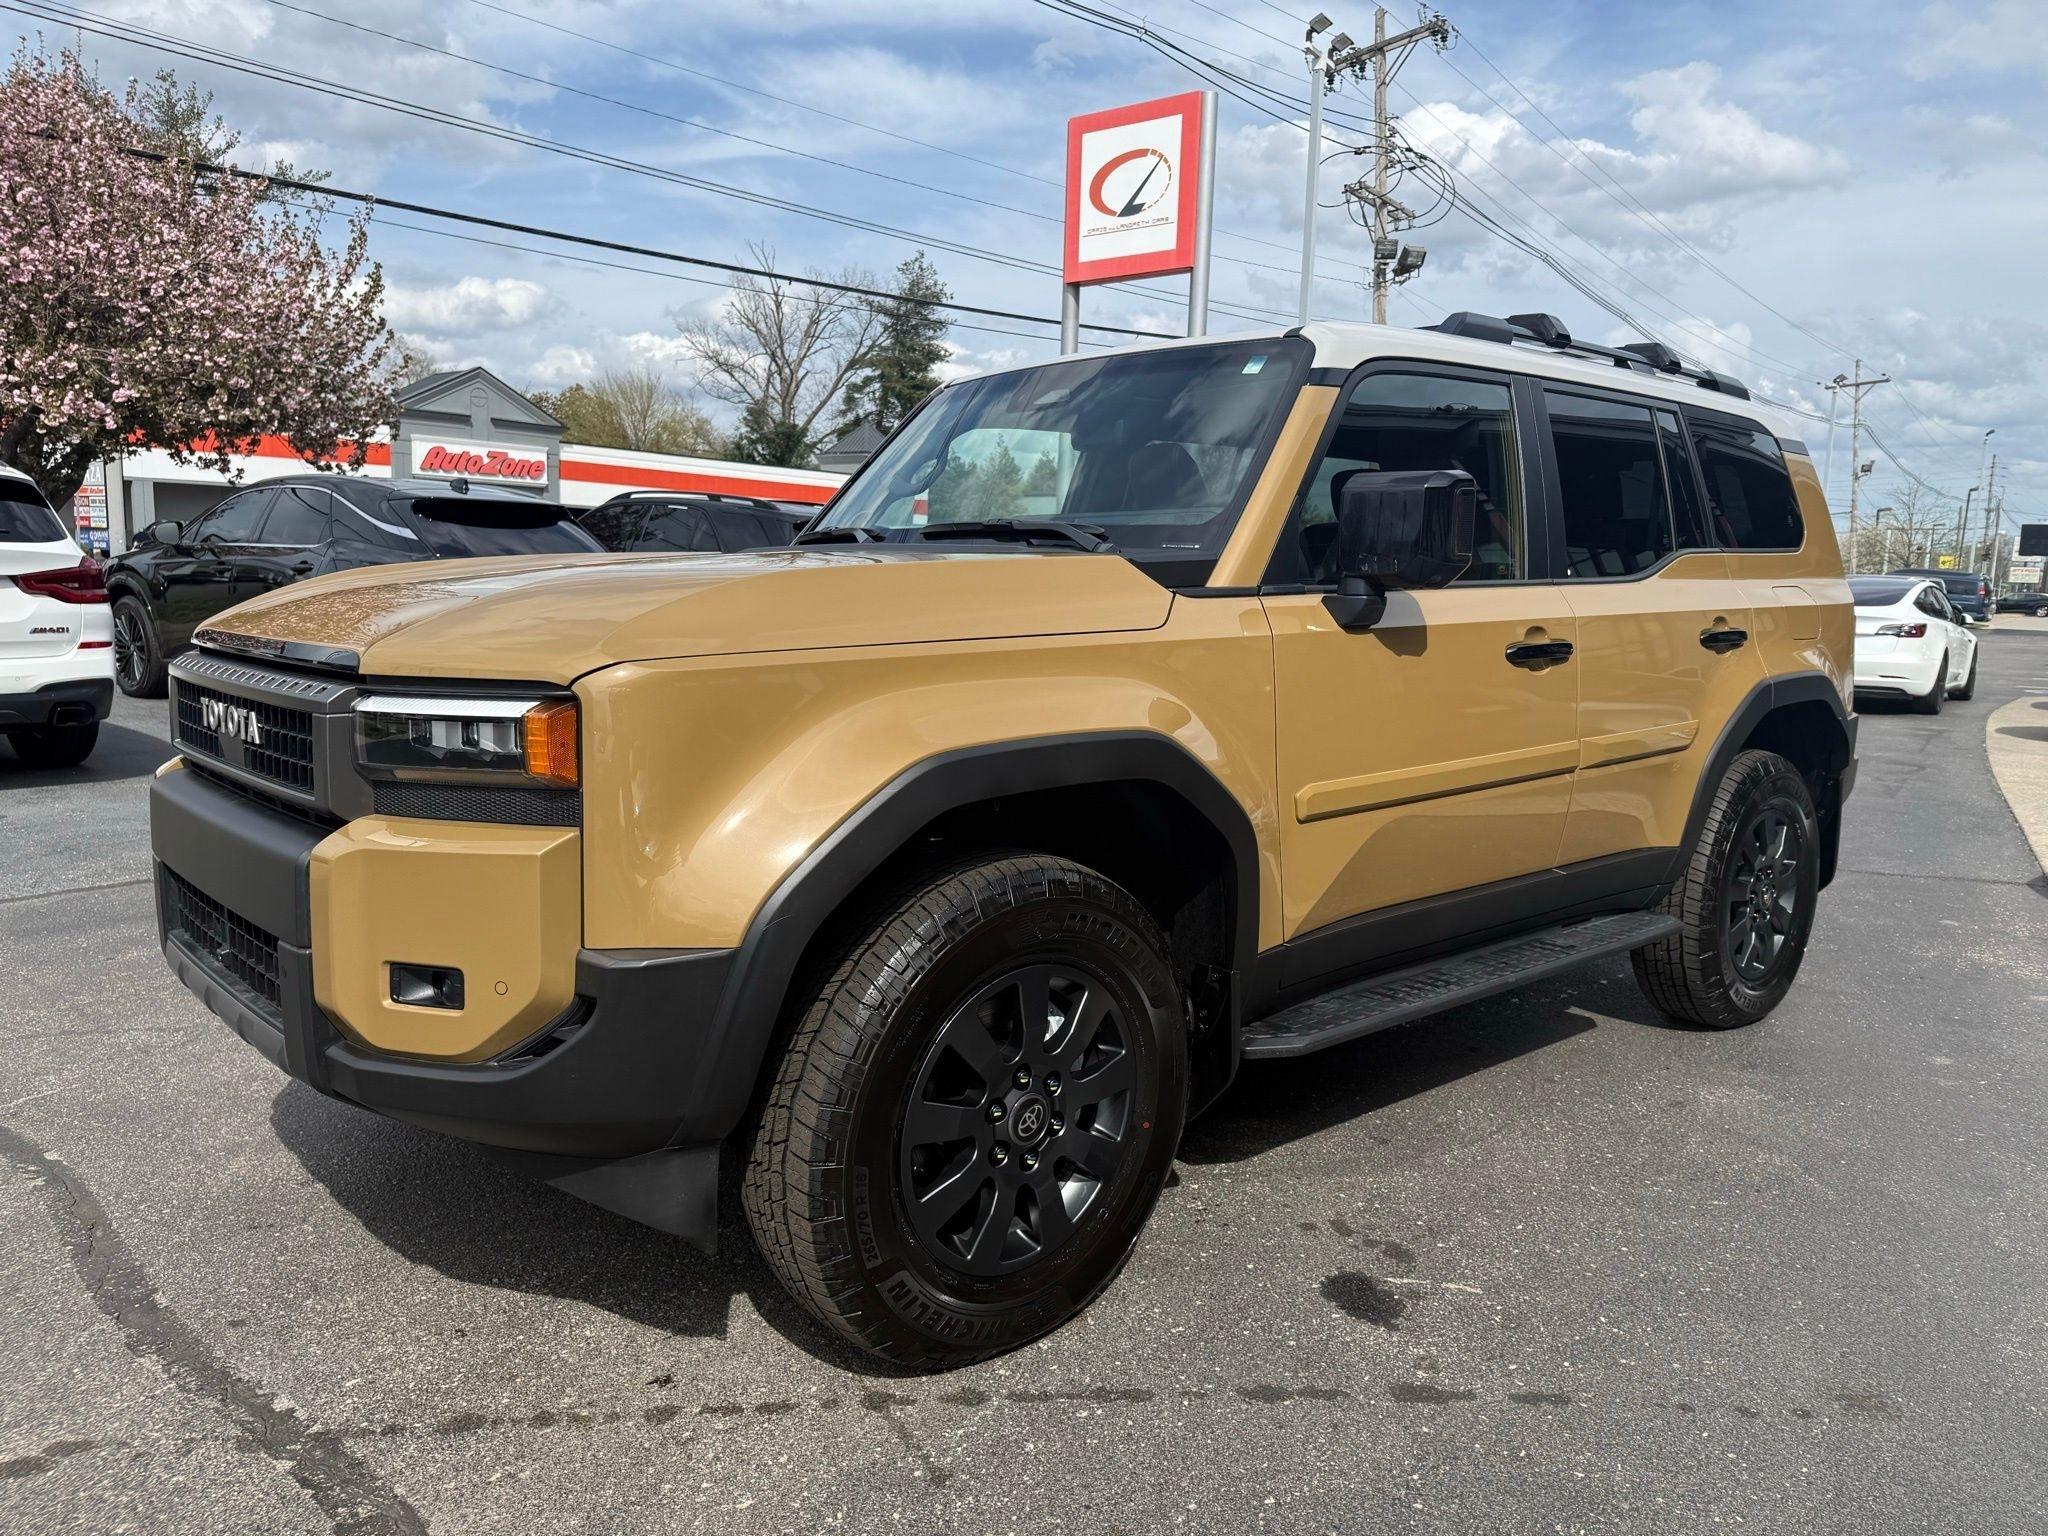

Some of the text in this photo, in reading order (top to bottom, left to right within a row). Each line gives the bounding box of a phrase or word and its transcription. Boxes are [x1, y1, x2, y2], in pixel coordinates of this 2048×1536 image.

[420, 446, 545, 480] AutoZone
[200, 697, 260, 745] TOYOTA
[887, 1279, 1009, 1341] MICHELIN
